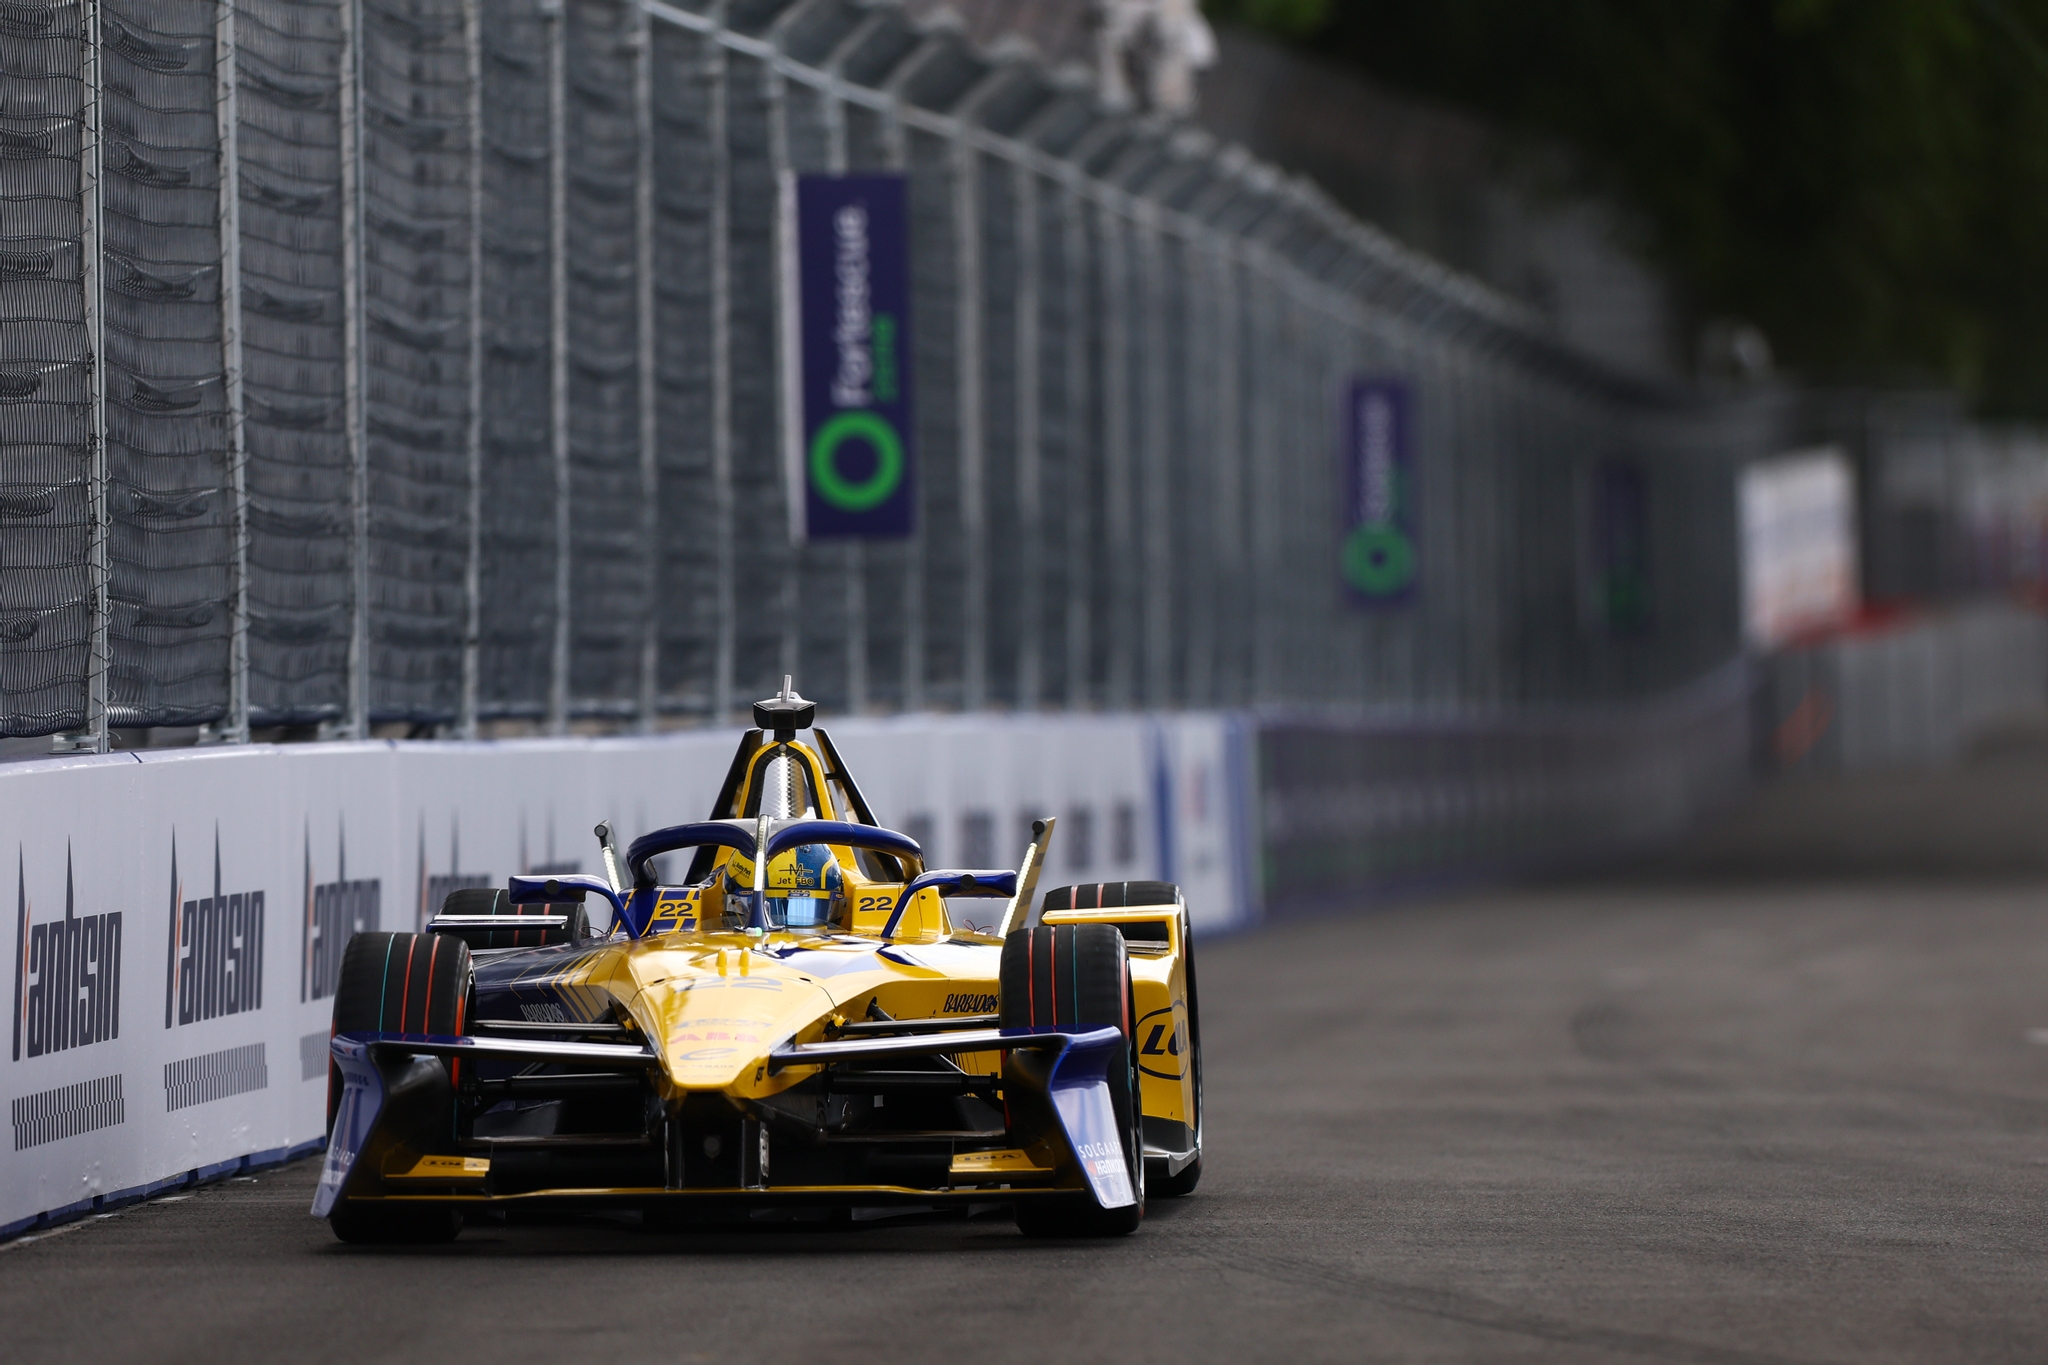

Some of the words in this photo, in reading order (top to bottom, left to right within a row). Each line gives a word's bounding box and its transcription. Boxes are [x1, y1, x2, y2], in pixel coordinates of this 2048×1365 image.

[777, 877, 792, 885] Jet
[659, 902, 693, 917] 22
[859, 896, 893, 912] 22
[674, 976, 783, 993] 22
[520, 1002, 565, 1022] BARBADOS
[669, 1032, 760, 1044] ABB
